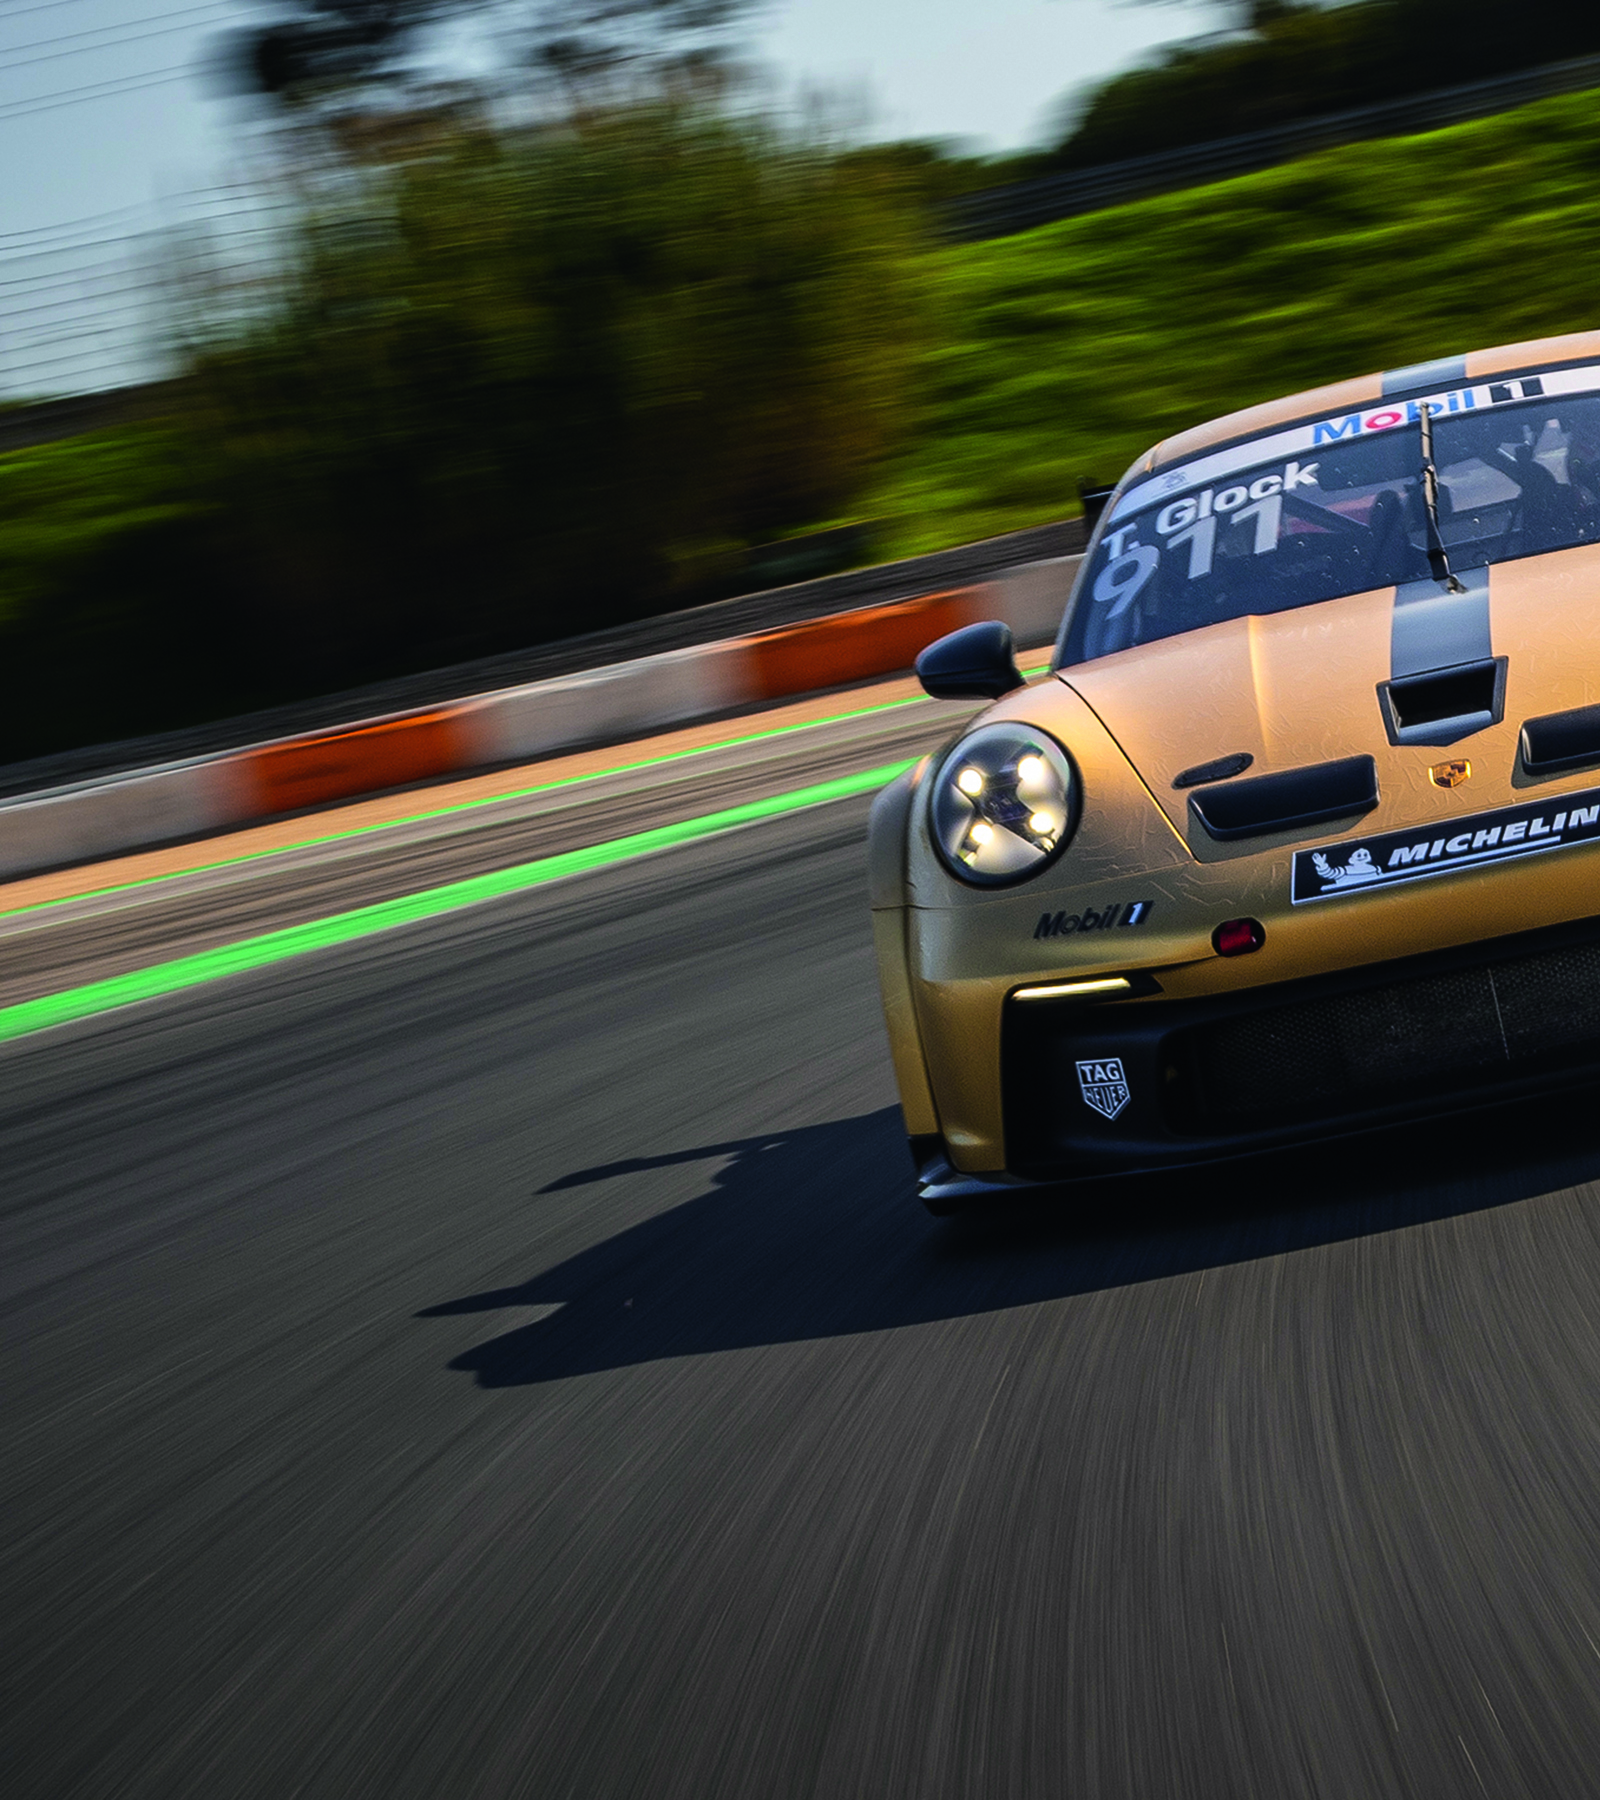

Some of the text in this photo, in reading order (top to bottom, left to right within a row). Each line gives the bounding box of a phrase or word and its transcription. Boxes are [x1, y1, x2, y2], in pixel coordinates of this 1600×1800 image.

[1312, 389, 1475, 445] Mobil
[1101, 522, 1141, 562] T.
[1156, 461, 1320, 535] Glock
[1093, 495, 1282, 620] 911
[1387, 804, 1600, 867] MICHELIN
[1033, 903, 1121, 939] Mobil
[1081, 1063, 1120, 1083] TAG
[1084, 1085, 1126, 1114] HEUER
